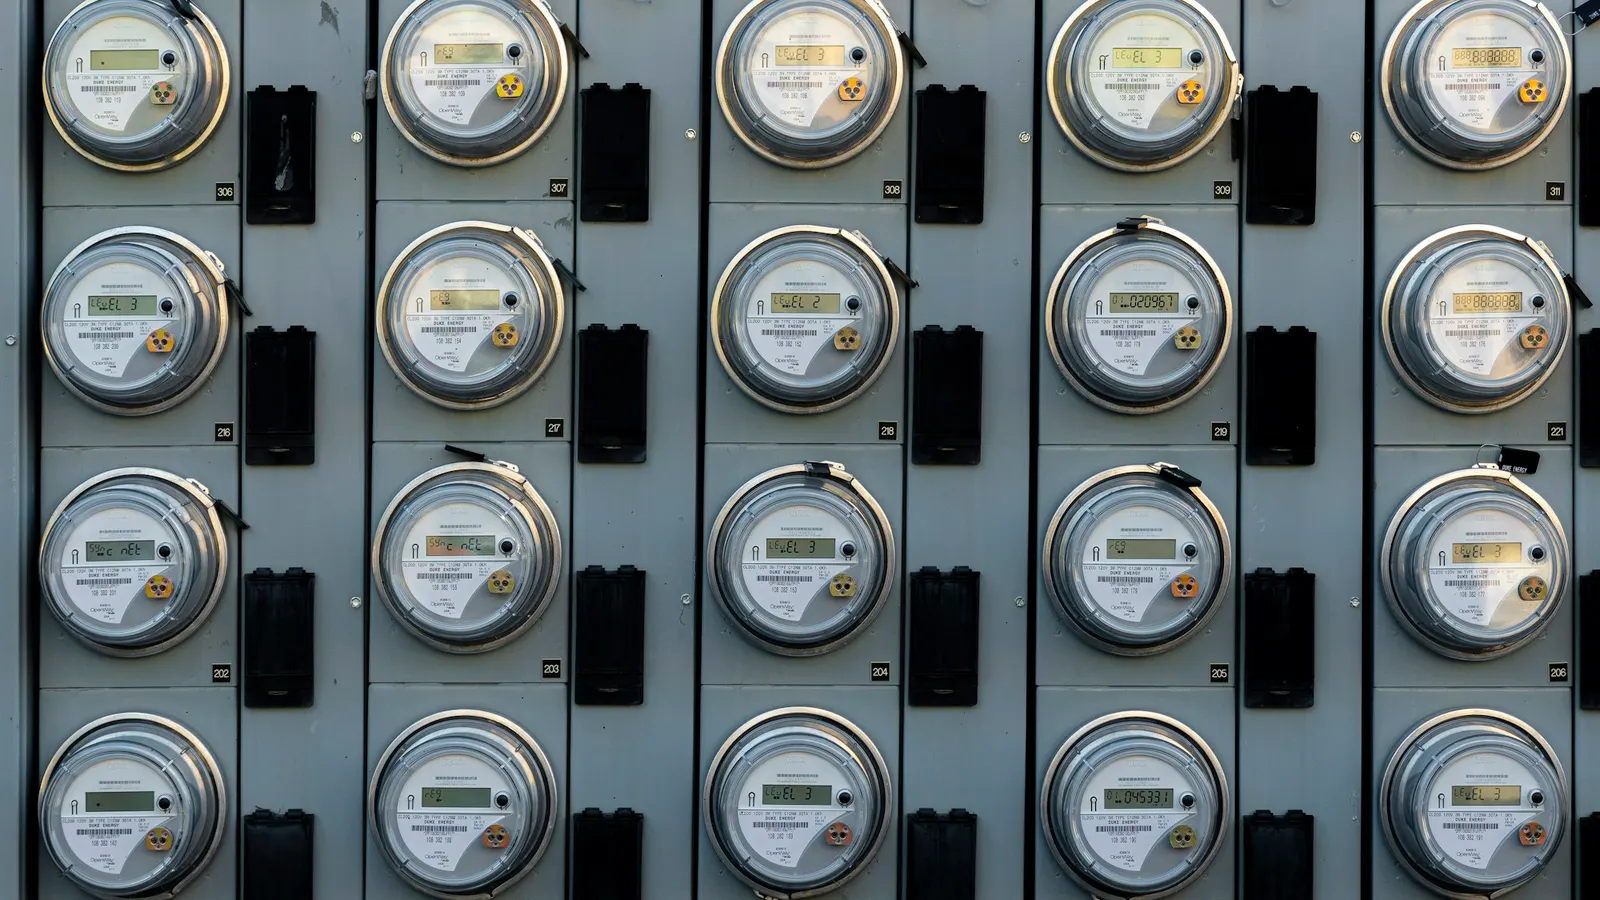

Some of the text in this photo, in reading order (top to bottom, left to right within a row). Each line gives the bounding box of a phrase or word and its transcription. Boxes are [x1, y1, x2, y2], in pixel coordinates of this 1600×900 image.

[819, 48, 824, 60] 3
[1156, 50, 1161, 63] 3
[218, 188, 233, 196] 306
[552, 184, 566, 192] 307
[885, 186, 900, 194] 308
[1215, 186, 1230, 194] 309
[1550, 187, 1560, 195] 311
[131, 298, 137, 310] 3
[813, 296, 820, 308] 2
[1130, 295, 1172, 308] 020967
[218, 428, 230, 436] 216
[548, 424, 561, 432] 217
[881, 427, 894, 435] 218
[1214, 428, 1227, 436] 219
[1551, 428, 1563, 436] 221
[809, 541, 815, 553] 3
[1495, 545, 1501, 557] 3
[544, 665, 559, 673] 203
[873, 668, 888, 676] 204
[1551, 668, 1566, 677] 206
[214, 670, 229, 678] 202
[1212, 670, 1227, 678] 205
[805, 787, 812, 800] 3
[1125, 791, 1167, 803] 045331
[1495, 788, 1500, 800] 3
